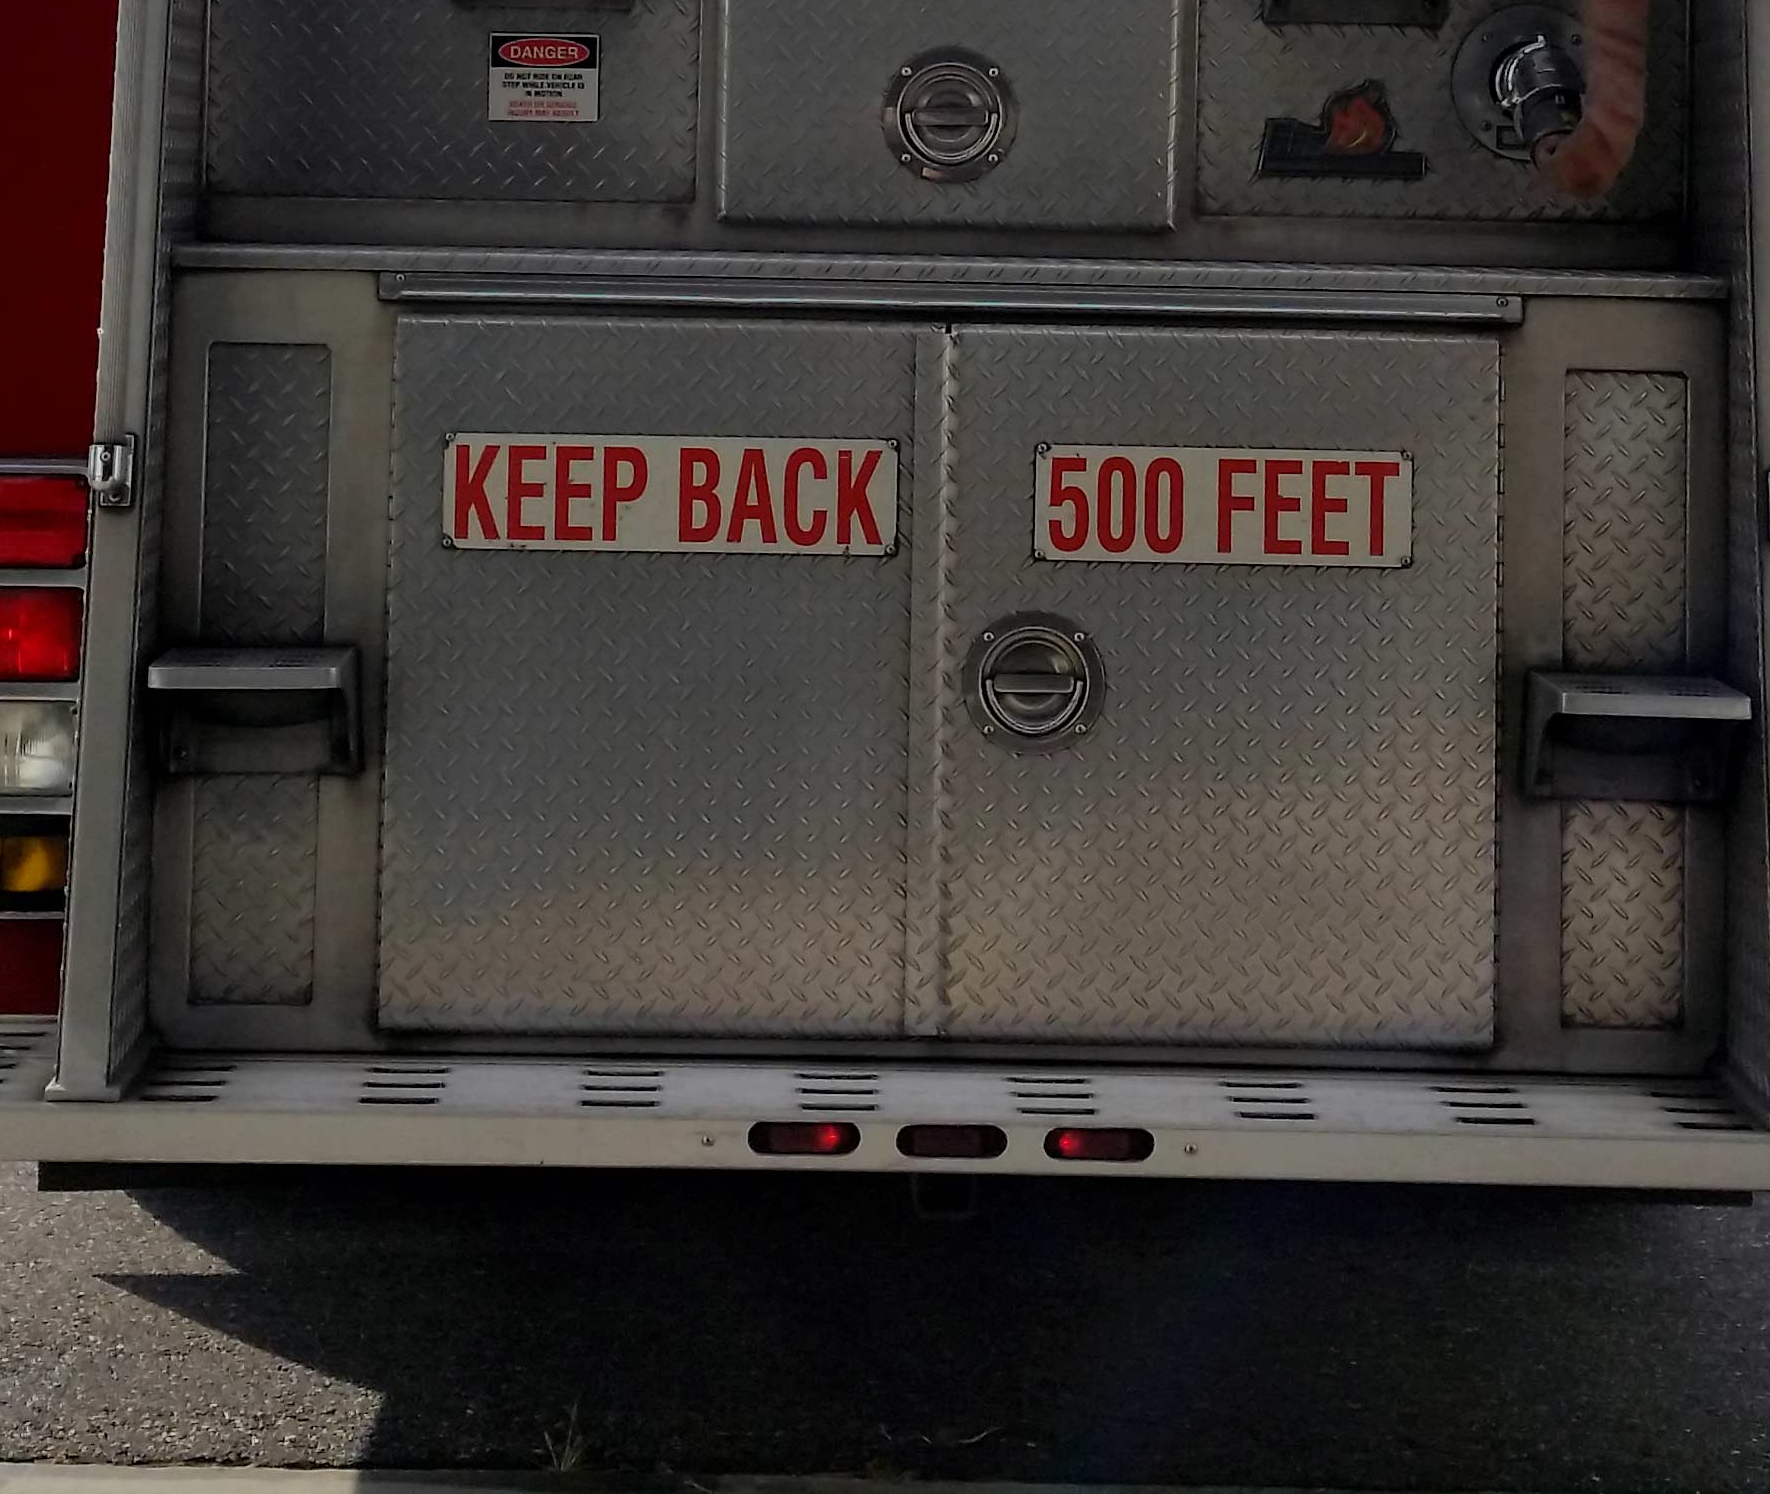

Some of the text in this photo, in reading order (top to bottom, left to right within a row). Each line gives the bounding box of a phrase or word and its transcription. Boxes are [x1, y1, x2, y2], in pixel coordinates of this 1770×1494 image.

[510, 46, 579, 59] DANGER
[454, 444, 883, 546] KEEP BACK
[1048, 457, 1400, 556] 500 FEET
